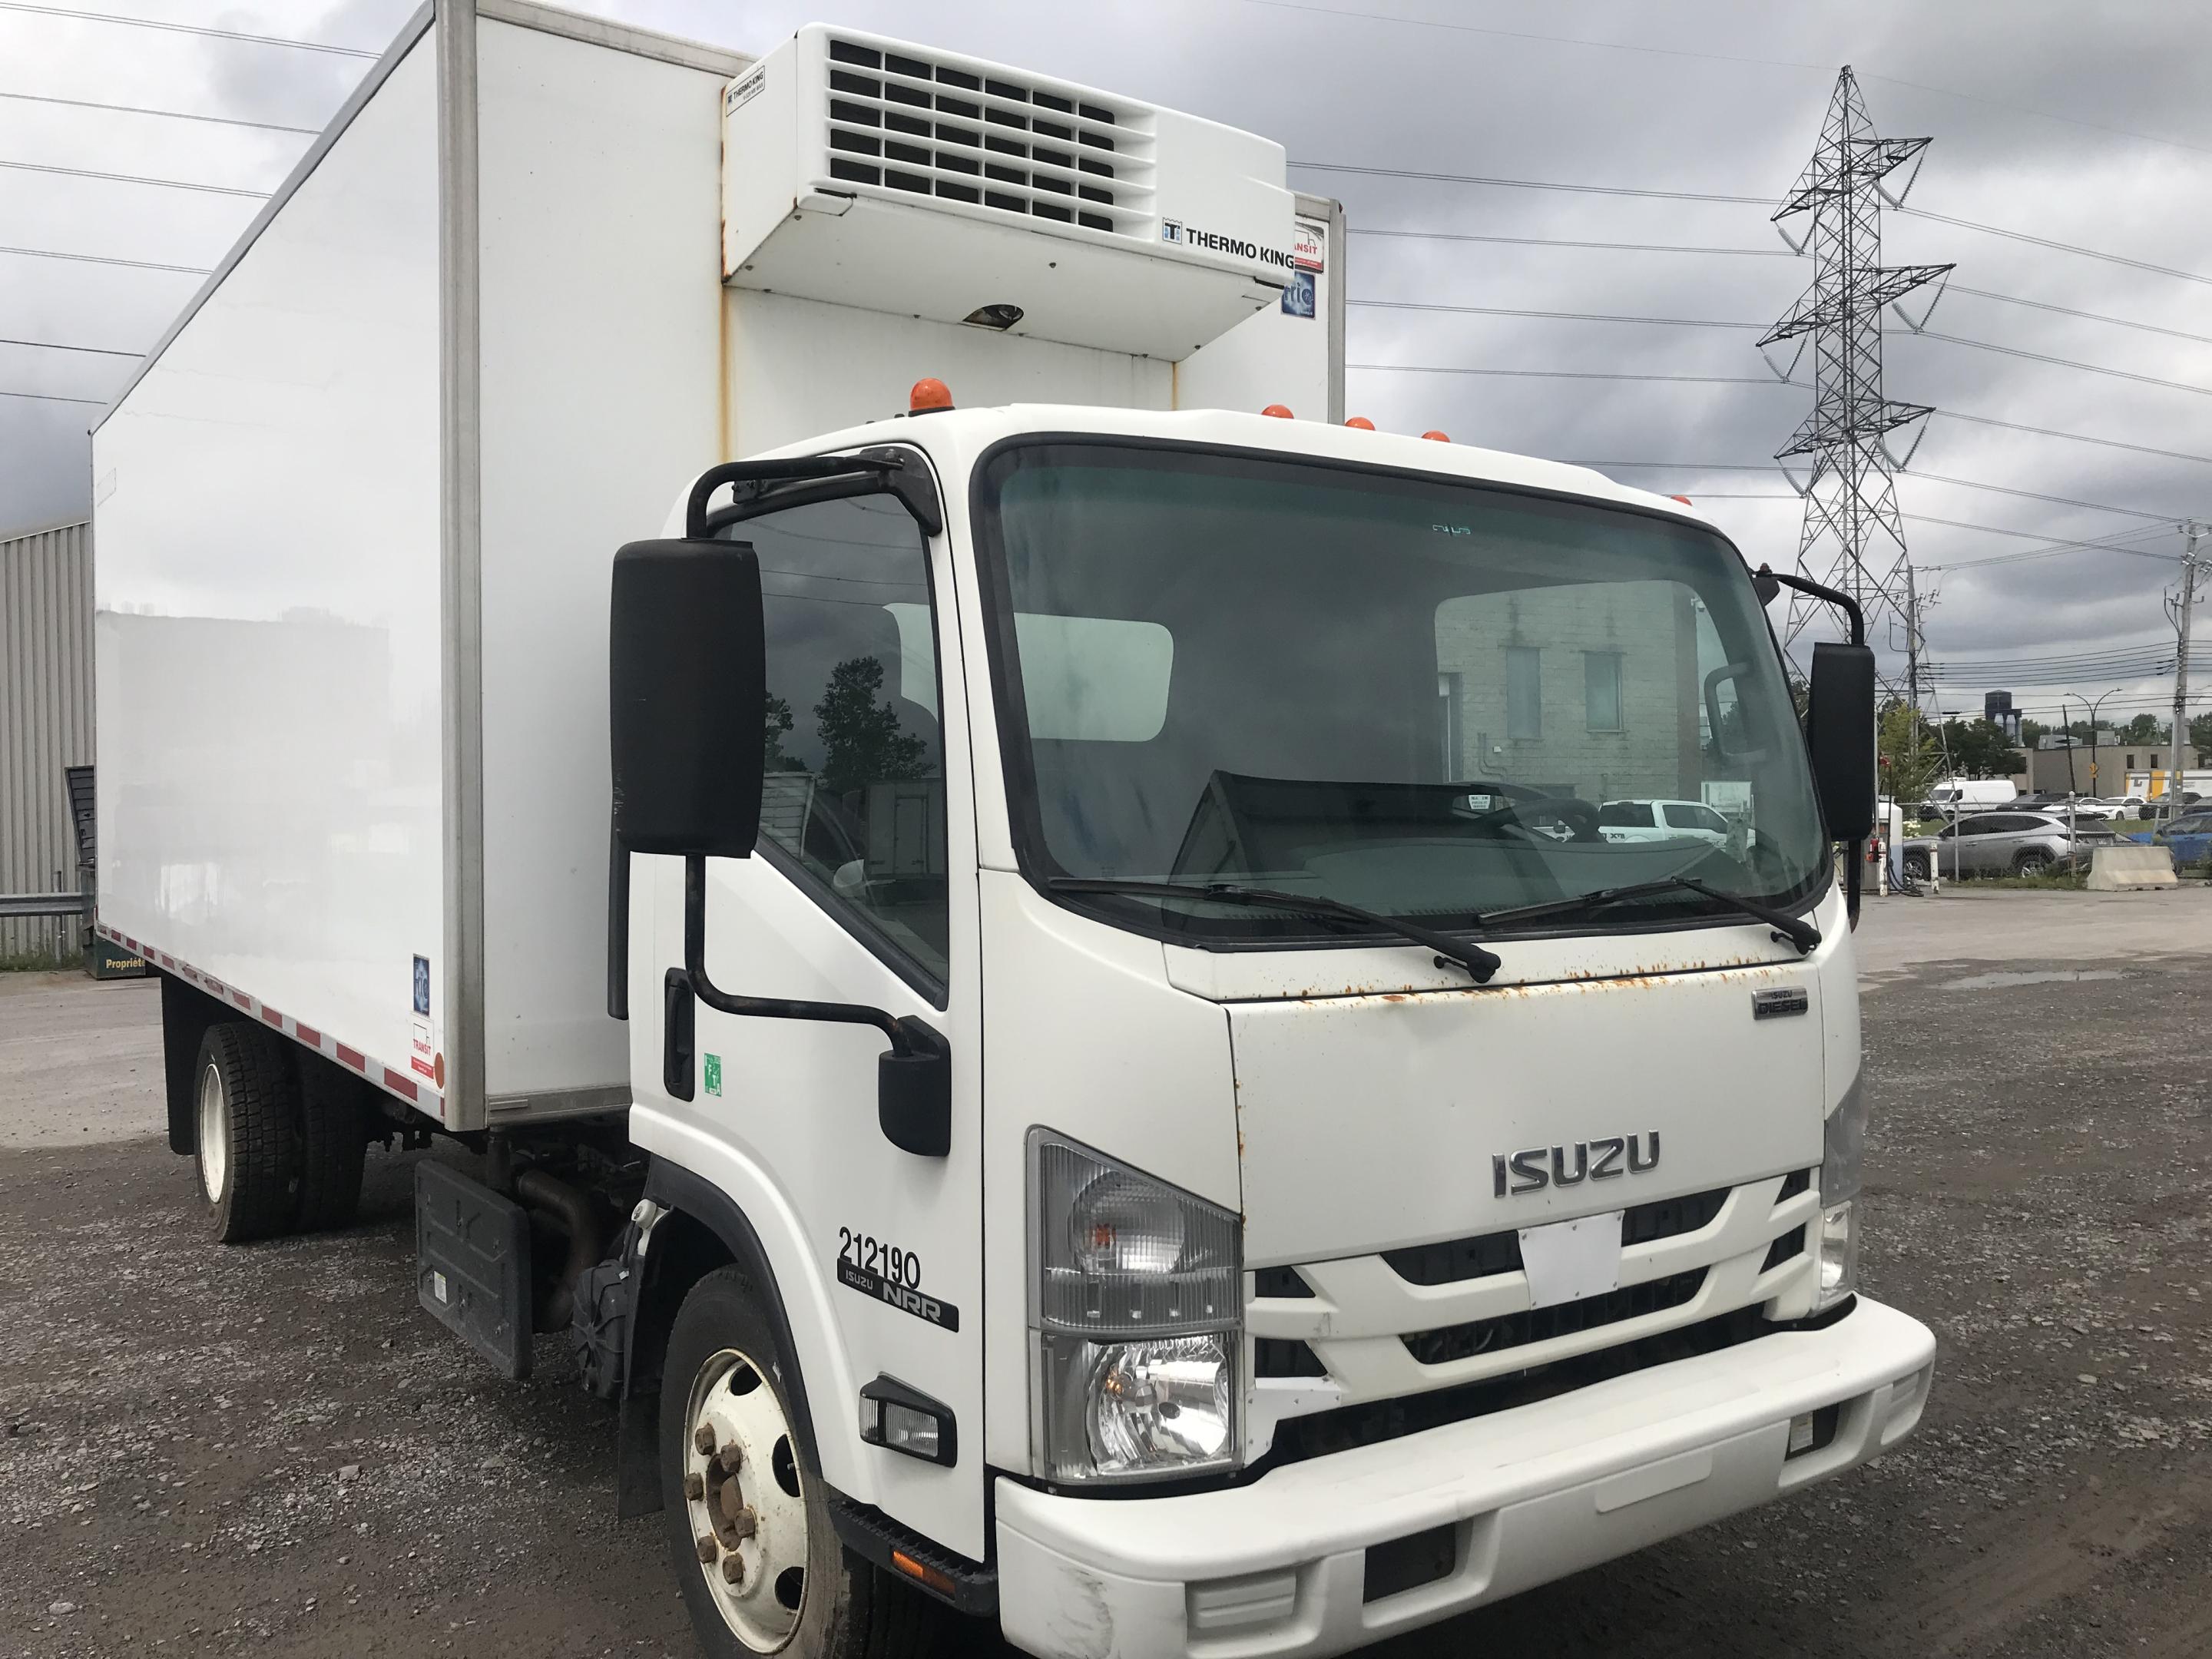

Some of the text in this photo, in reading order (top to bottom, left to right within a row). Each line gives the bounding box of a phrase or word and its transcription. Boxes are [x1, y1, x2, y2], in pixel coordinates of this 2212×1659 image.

[733, 81, 752, 100] THERMO
[752, 71, 763, 86] KING
[1186, 227, 1257, 259] THERMO
[1260, 246, 1295, 270] KING
[1770, 990, 1793, 999] ISUZU
[412, 1038, 432, 1056] TRANSIT
[1492, 1129, 1660, 1198] ISUZU
[839, 1226, 921, 1290] 212190
[846, 1270, 941, 1323] ISUZU NRR
